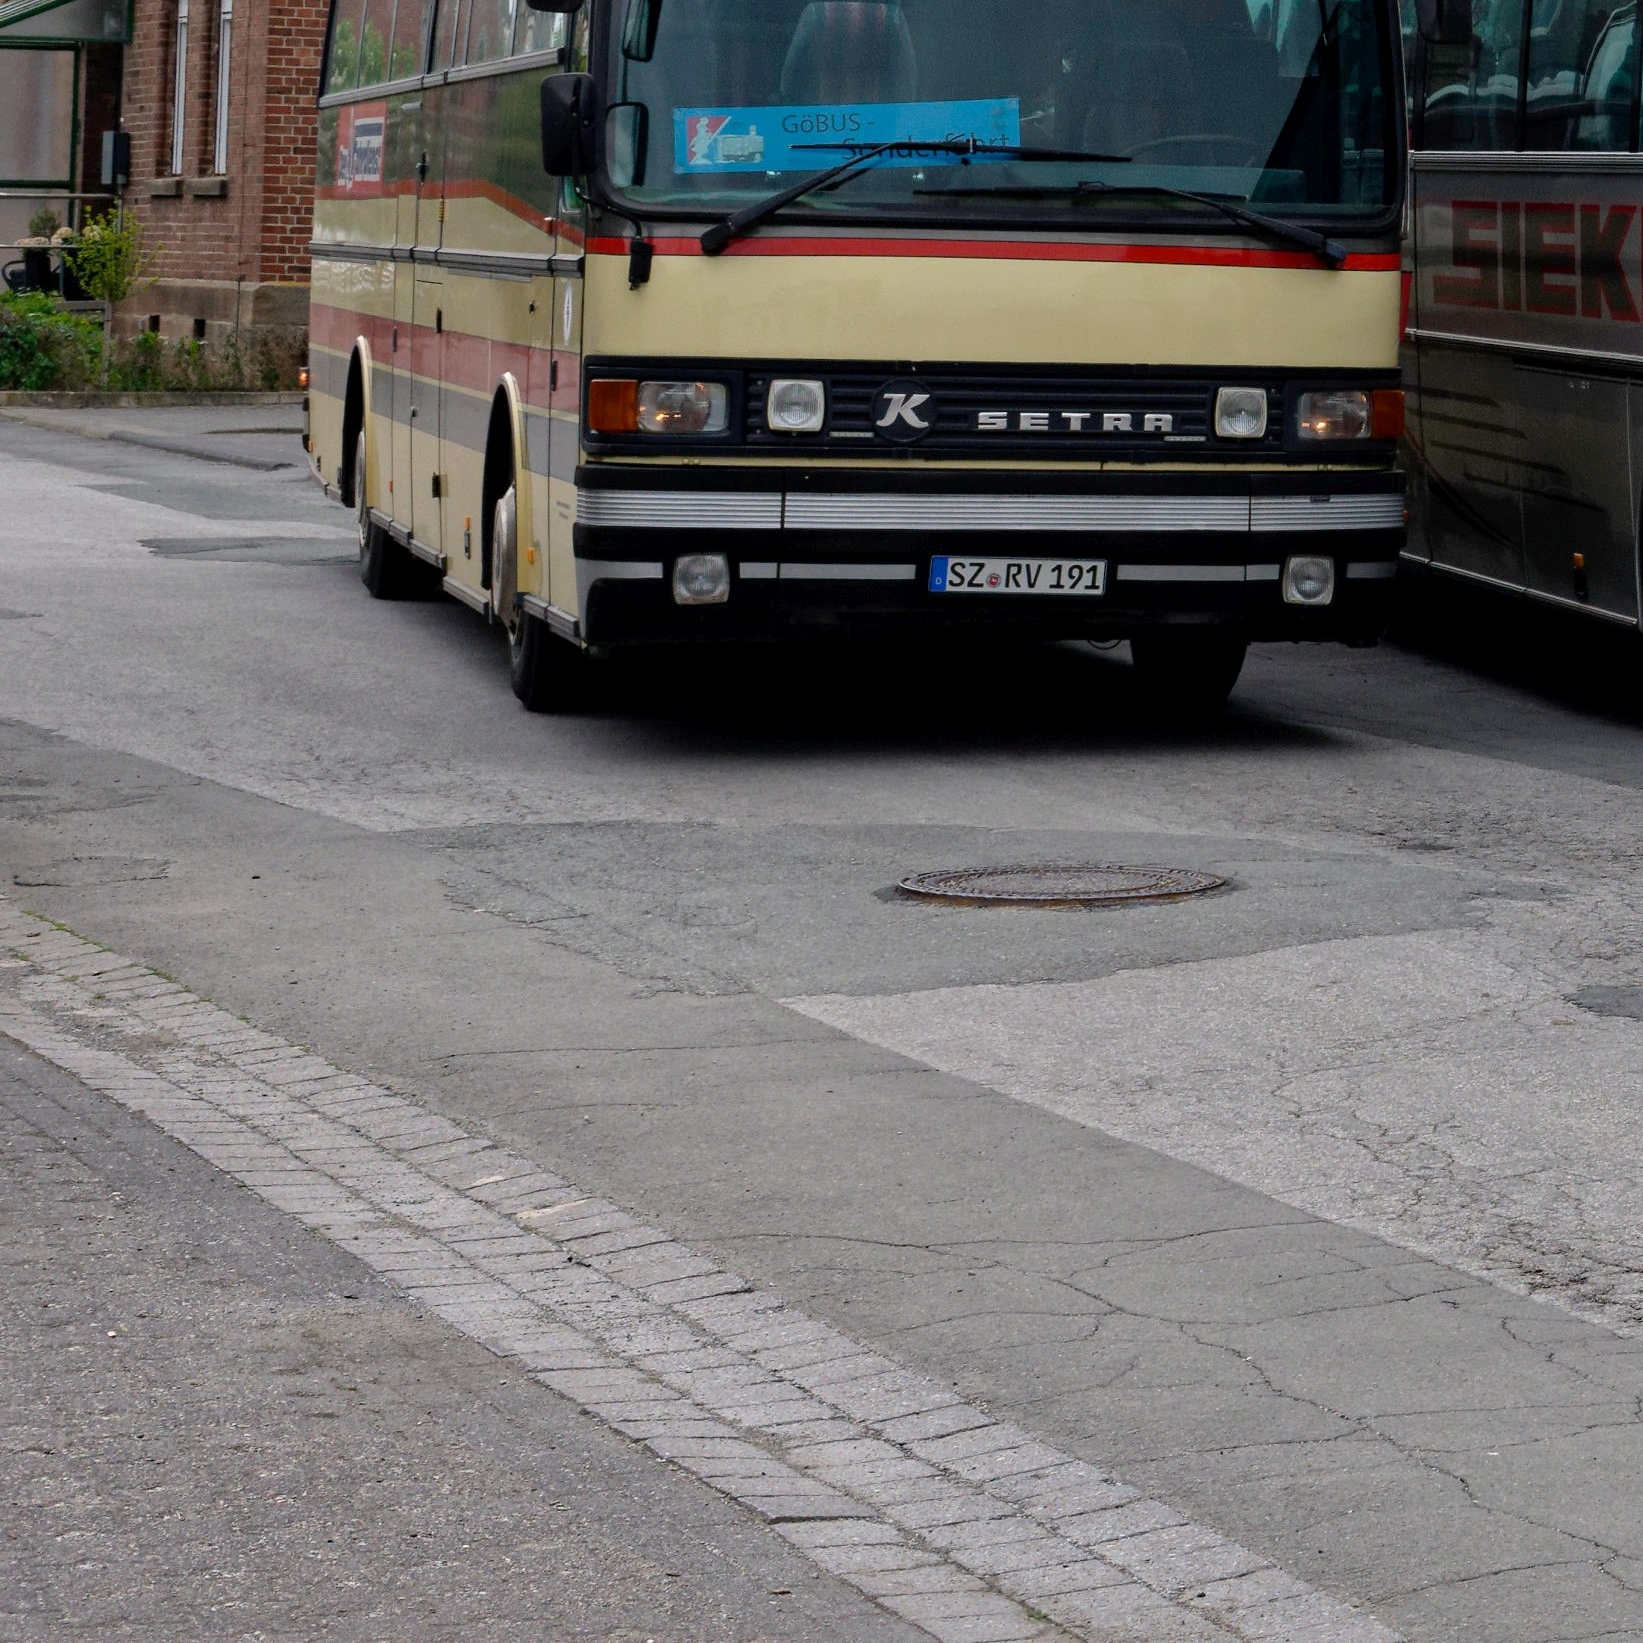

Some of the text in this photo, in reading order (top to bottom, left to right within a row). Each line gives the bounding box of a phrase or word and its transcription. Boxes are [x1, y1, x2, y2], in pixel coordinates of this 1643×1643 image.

[782, 113, 860, 134] GöBUS
[977, 411, 1174, 432] SETRA
[948, 562, 985, 588] SZ
[1004, 563, 1042, 589] RV
[1049, 564, 1100, 590] 191
